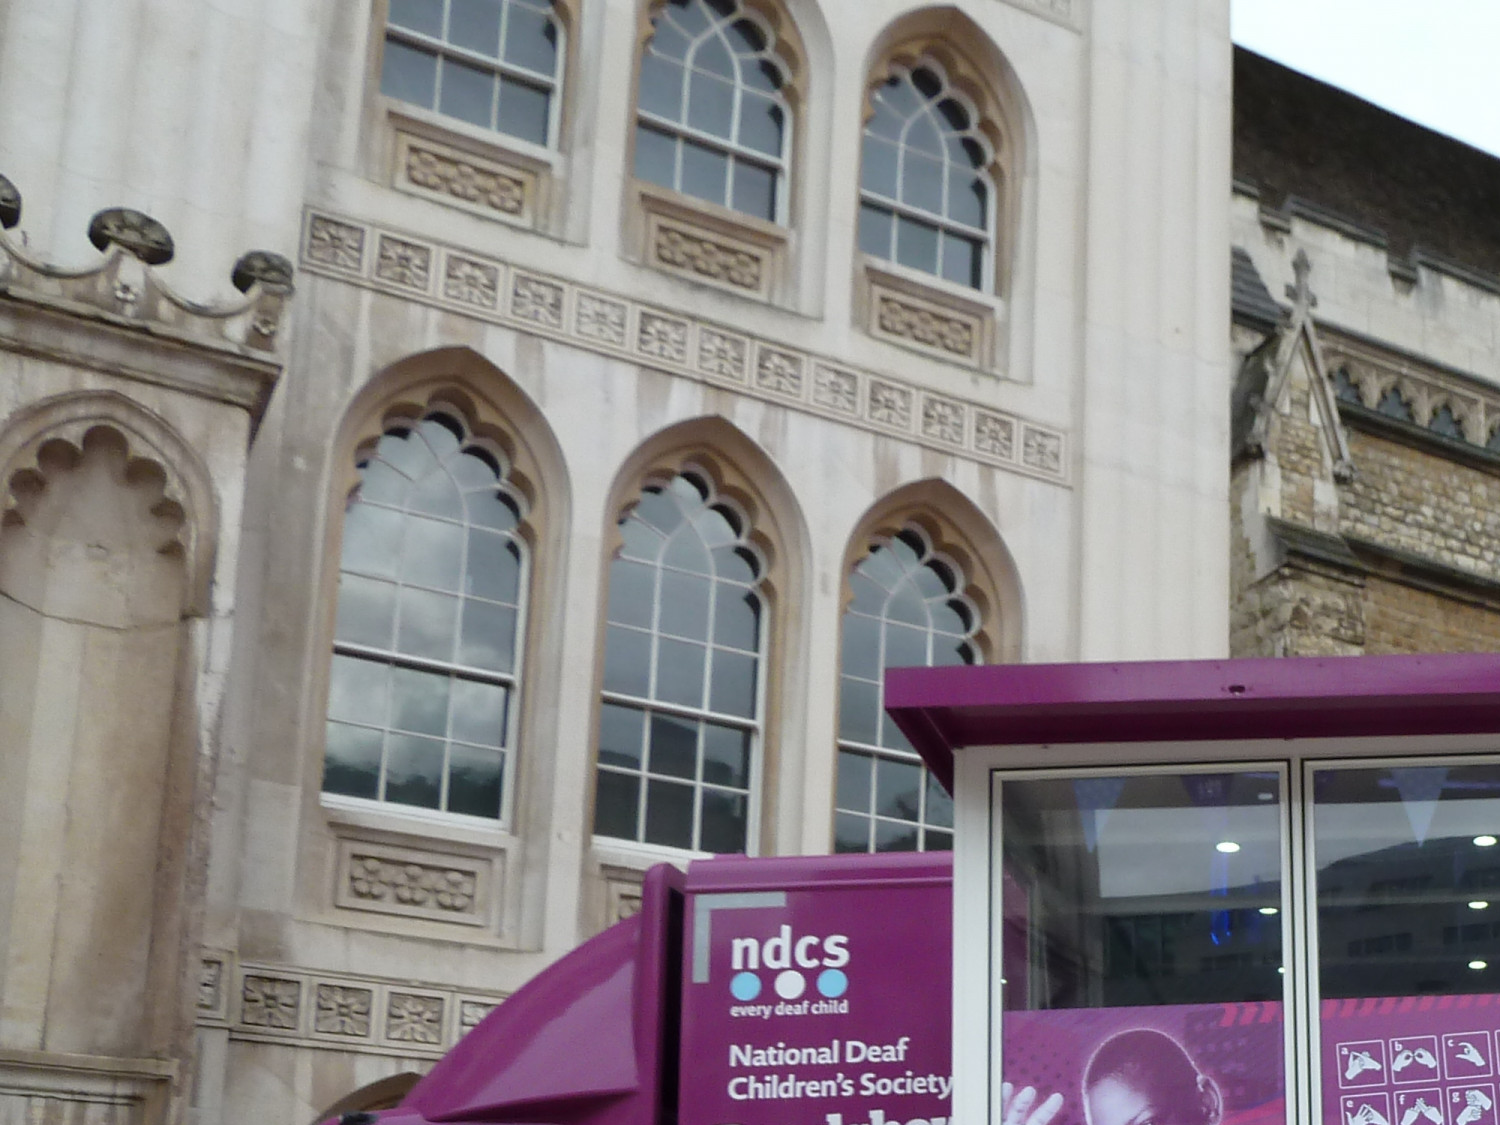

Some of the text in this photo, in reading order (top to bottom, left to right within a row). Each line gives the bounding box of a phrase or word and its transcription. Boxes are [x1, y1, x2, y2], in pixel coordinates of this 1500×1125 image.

[731, 924, 850, 970] ndcs
[730, 1000, 848, 1019] every deaf child
[729, 1037, 910, 1067] National Deaf
[727, 1071, 952, 1101] Children’s Society
